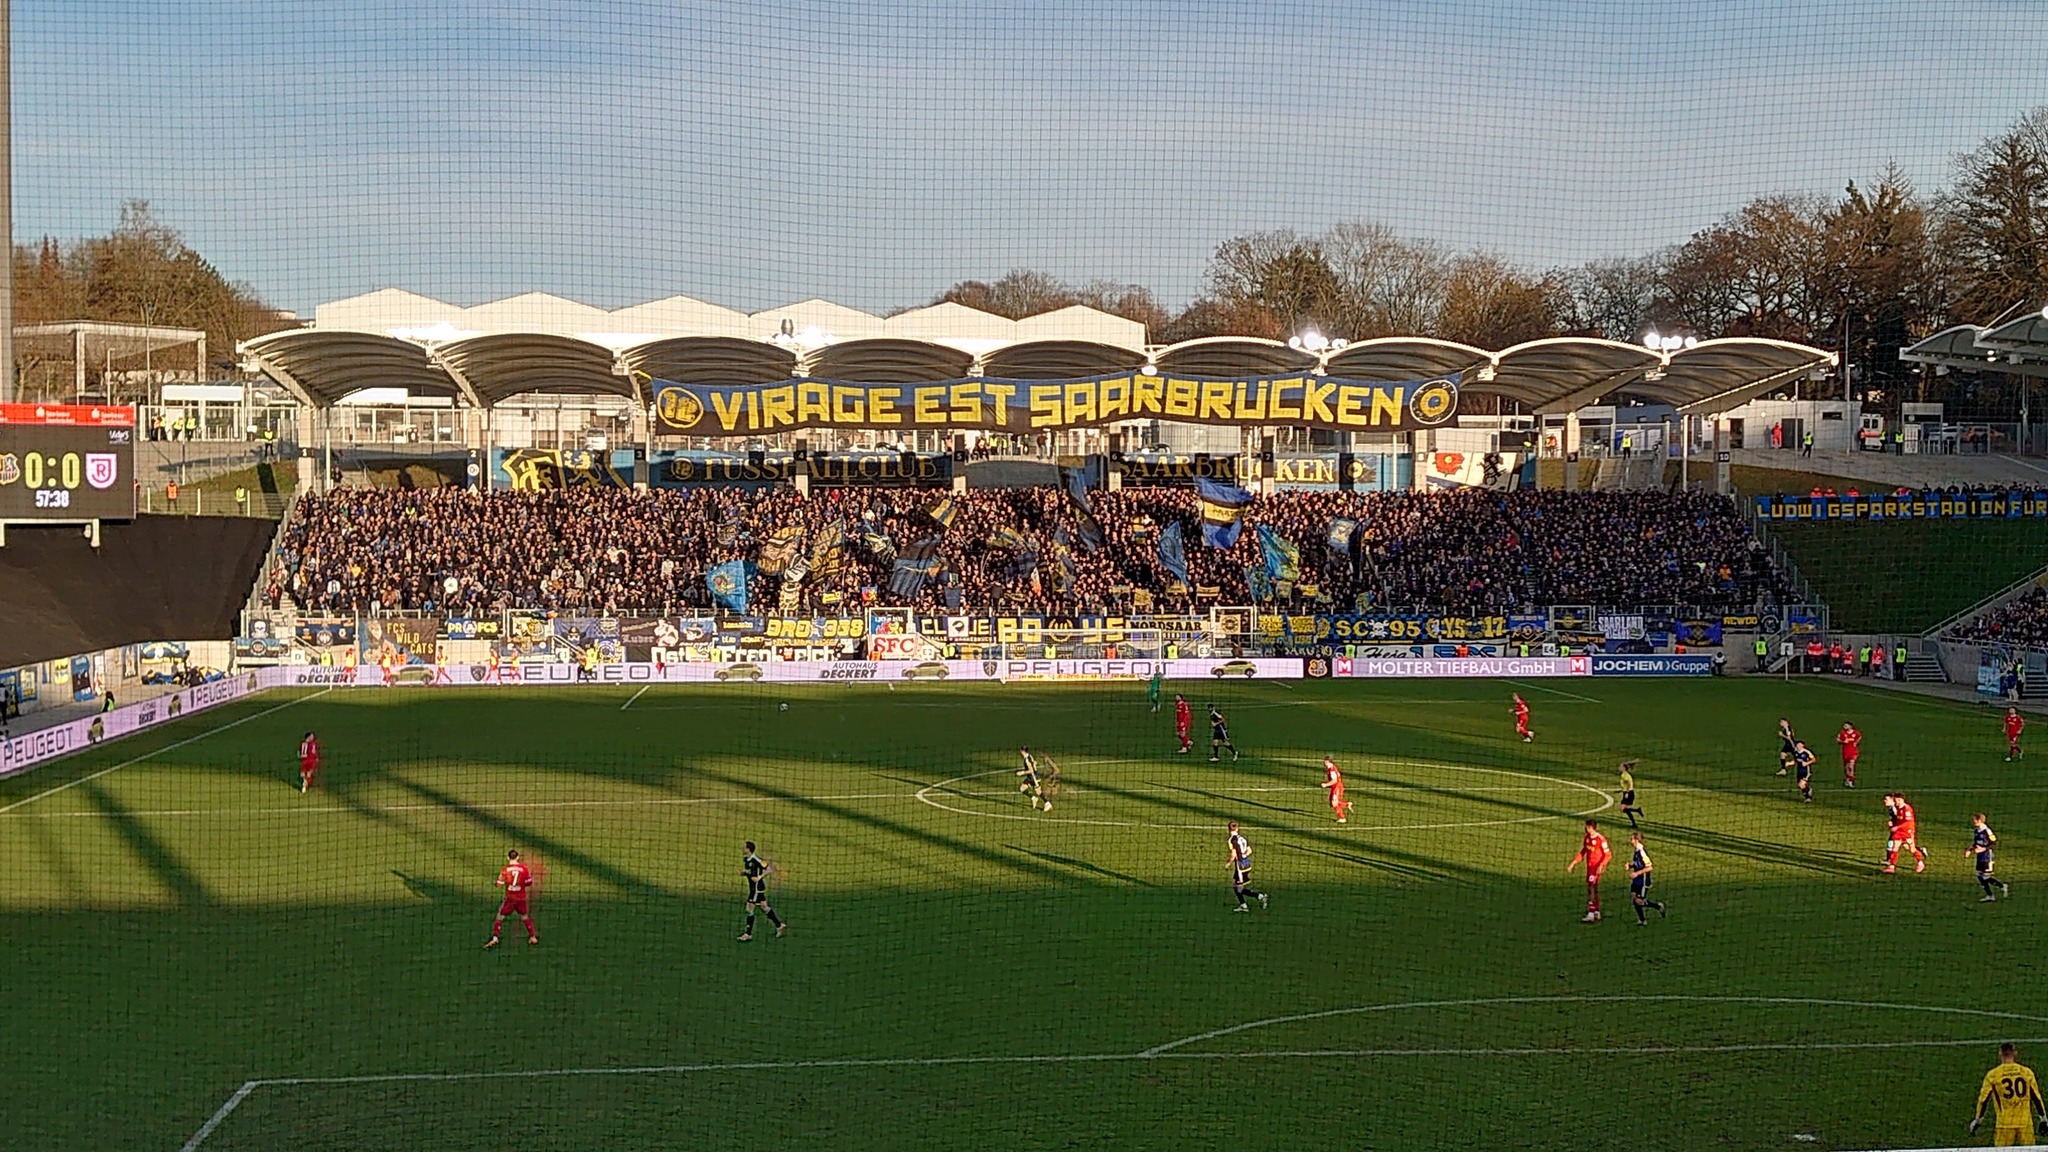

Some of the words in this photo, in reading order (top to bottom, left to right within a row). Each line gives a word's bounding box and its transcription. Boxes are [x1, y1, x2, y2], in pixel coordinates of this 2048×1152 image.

[711, 383, 903, 430] VIRAGE
[915, 383, 1016, 427] EST
[1030, 376, 1405, 427] SAARBRÜCKEN
[25, 452, 80, 489] 0:0
[1756, 501, 2006, 518] LUDWIGSPARKSTADION
[387, 622, 405, 633] FCS
[477, 621, 498, 633] FCS
[1130, 621, 1202, 631] NORDSAAR
[1336, 620, 1369, 636] SC
[1389, 620, 1421, 637] 95
[1484, 616, 1504, 638] 17
[396, 632, 420, 643] WILD
[874, 637, 915, 653] SFC
[410, 642, 434, 654] CATS
[1543, 645, 1554, 654] E4
[821, 669, 877, 679] DECKERT
[1369, 661, 1434, 674] MOLTER
[1436, 661, 1502, 674] TIEFBAU
[1508, 661, 1555, 674] GmbH
[1594, 660, 1664, 671] JOCHEM
[1671, 661, 1710, 673] Gruppe
[195, 679, 239, 706] PEUGEOT
[4, 727, 73, 766] PEUGEOT
[512, 871, 519, 886] 7
[2001, 1077, 2027, 1099] 30
